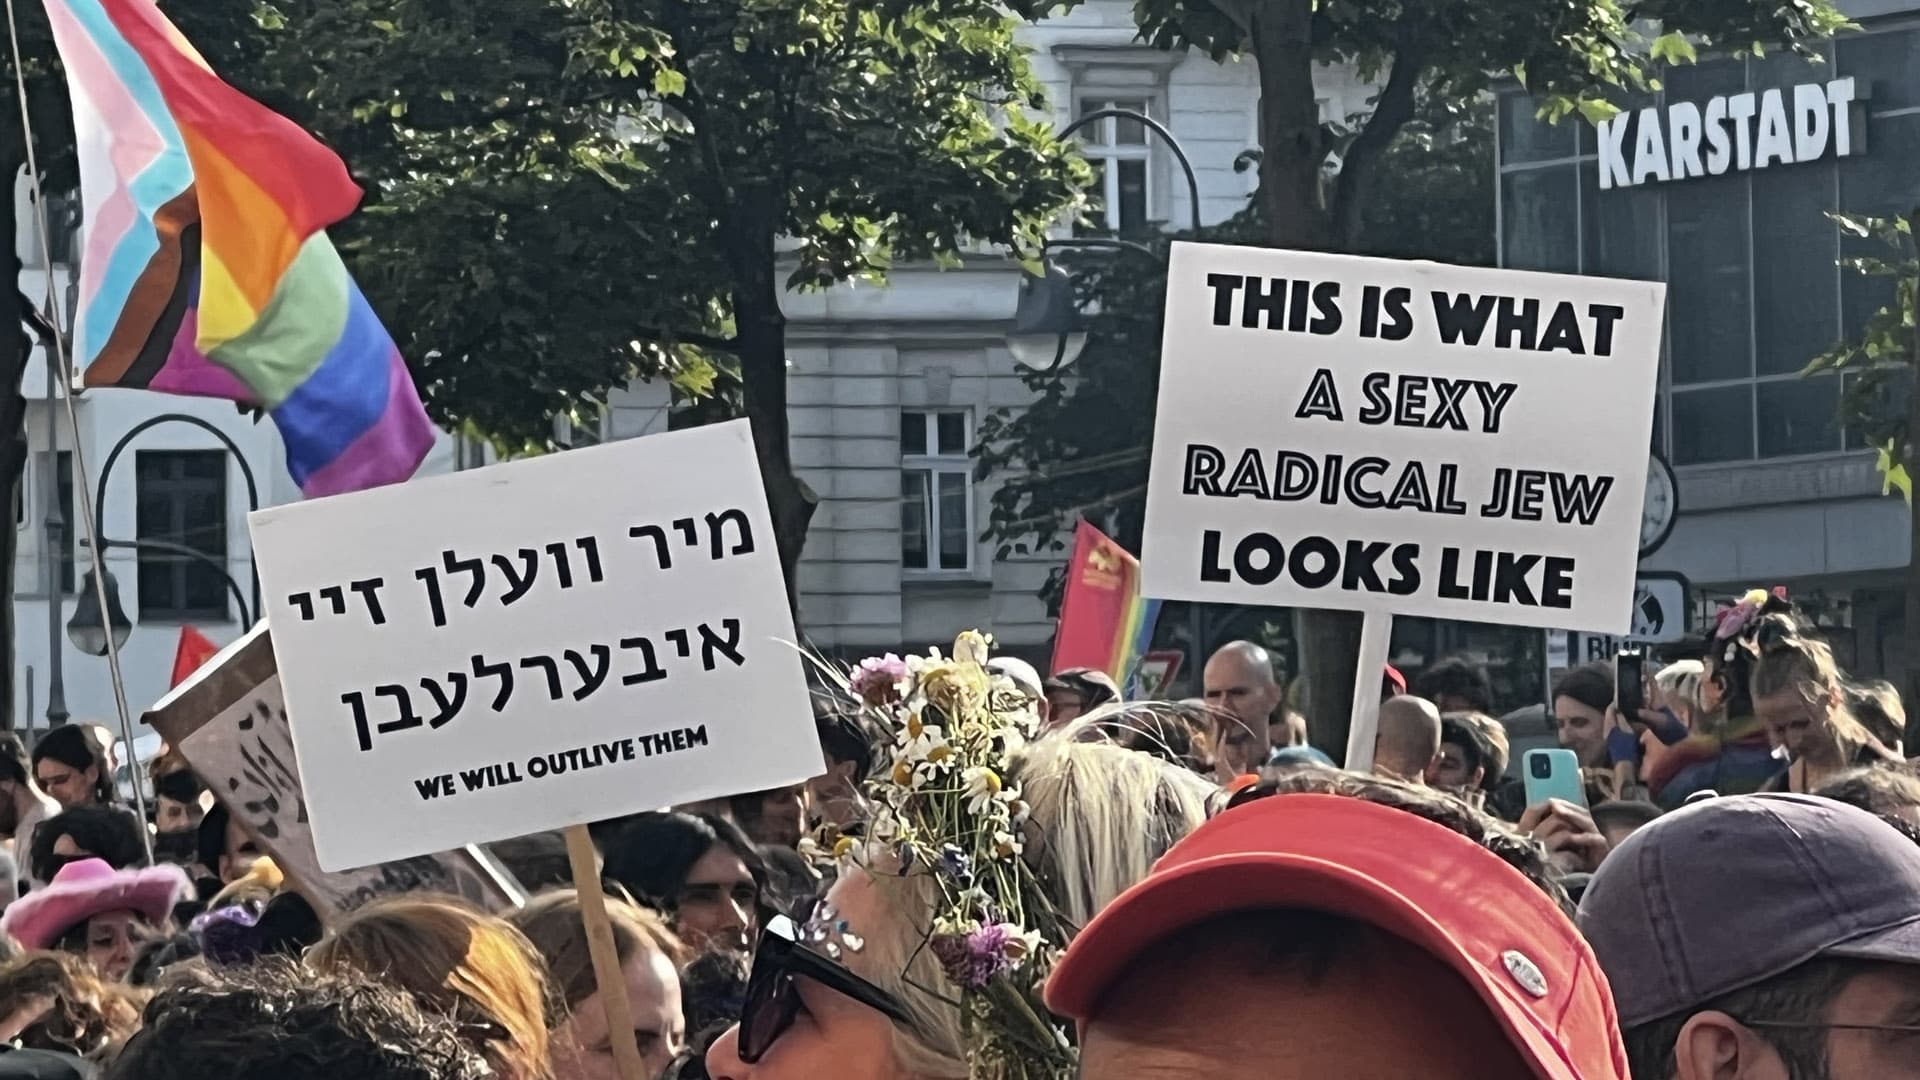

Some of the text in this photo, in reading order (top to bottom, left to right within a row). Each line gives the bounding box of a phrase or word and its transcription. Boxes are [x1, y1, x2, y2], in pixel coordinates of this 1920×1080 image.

[1597, 76, 1856, 190] KARSTADT
[1207, 273, 1624, 357] THIS IS WHAT
[1294, 368, 1518, 434] A SEXY
[1182, 443, 1615, 526] RADICAL JEW
[288, 508, 755, 628] מיר וועלן זיי
[1200, 529, 1576, 609] LOOKS LIKE
[340, 618, 746, 752] איבערלעבן
[414, 724, 709, 801] WE WILL OUTLIVE THEM
